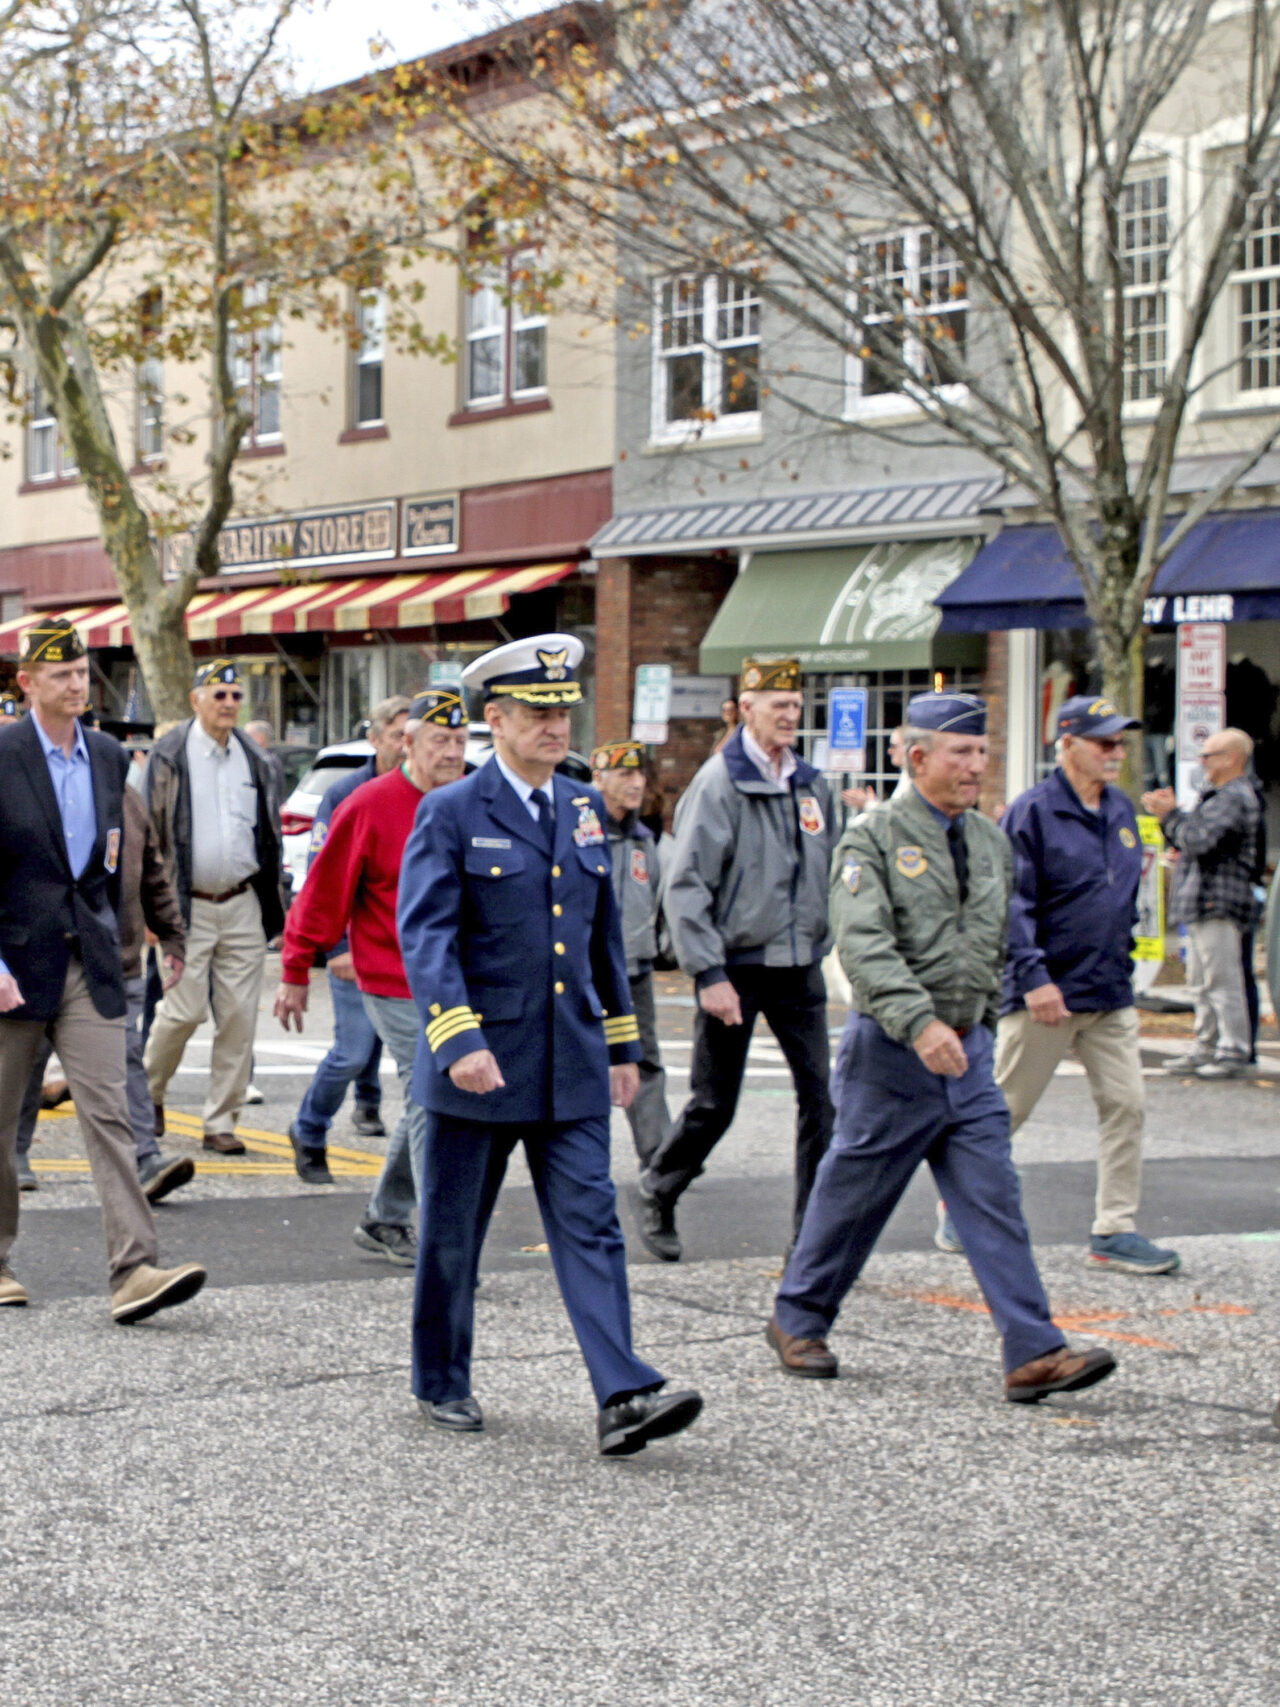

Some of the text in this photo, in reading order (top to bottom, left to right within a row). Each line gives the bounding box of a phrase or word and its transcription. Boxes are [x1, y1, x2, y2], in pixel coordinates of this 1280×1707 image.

[218, 519, 297, 564] ARIETY
[300, 513, 363, 556] STORE
[1173, 594, 1234, 622] LEHR
